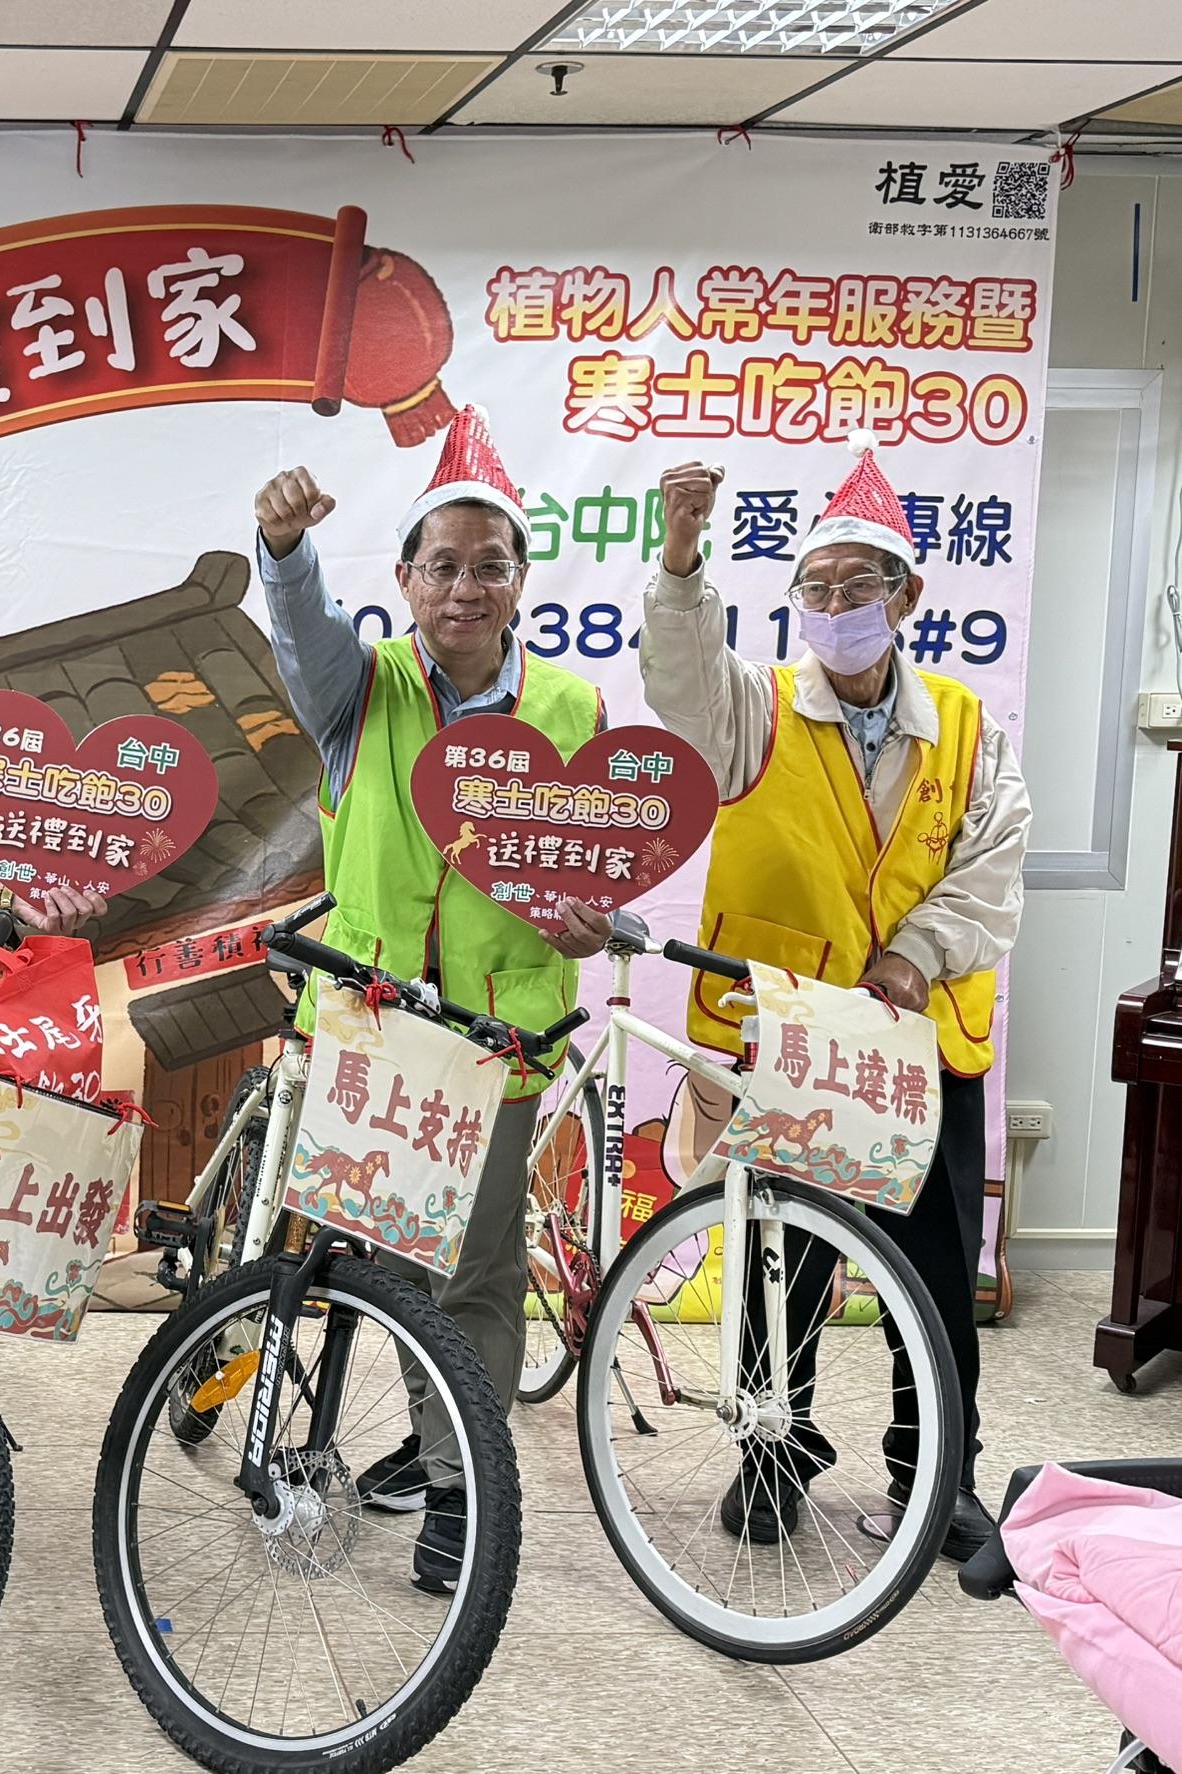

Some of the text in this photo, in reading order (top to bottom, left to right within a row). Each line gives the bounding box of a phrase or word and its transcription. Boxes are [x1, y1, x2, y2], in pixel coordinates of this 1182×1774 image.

[874, 161, 986, 210] 植愛
[486, 266, 1038, 352] 植物人常年服務暨
[563, 350, 1029, 446] 寒士吃飽30
[731, 490, 1013, 567] 愛專線
[117, 738, 180, 775] 台中
[444, 745, 531, 774] 第36屆
[608, 750, 674, 784] 台中
[452, 775, 671, 831] 寒士吃飽30
[487, 832, 635, 881] 送禮到家
[773, 1023, 927, 1125] 馬上達標
[326, 1049, 482, 1178] 馬上支持
